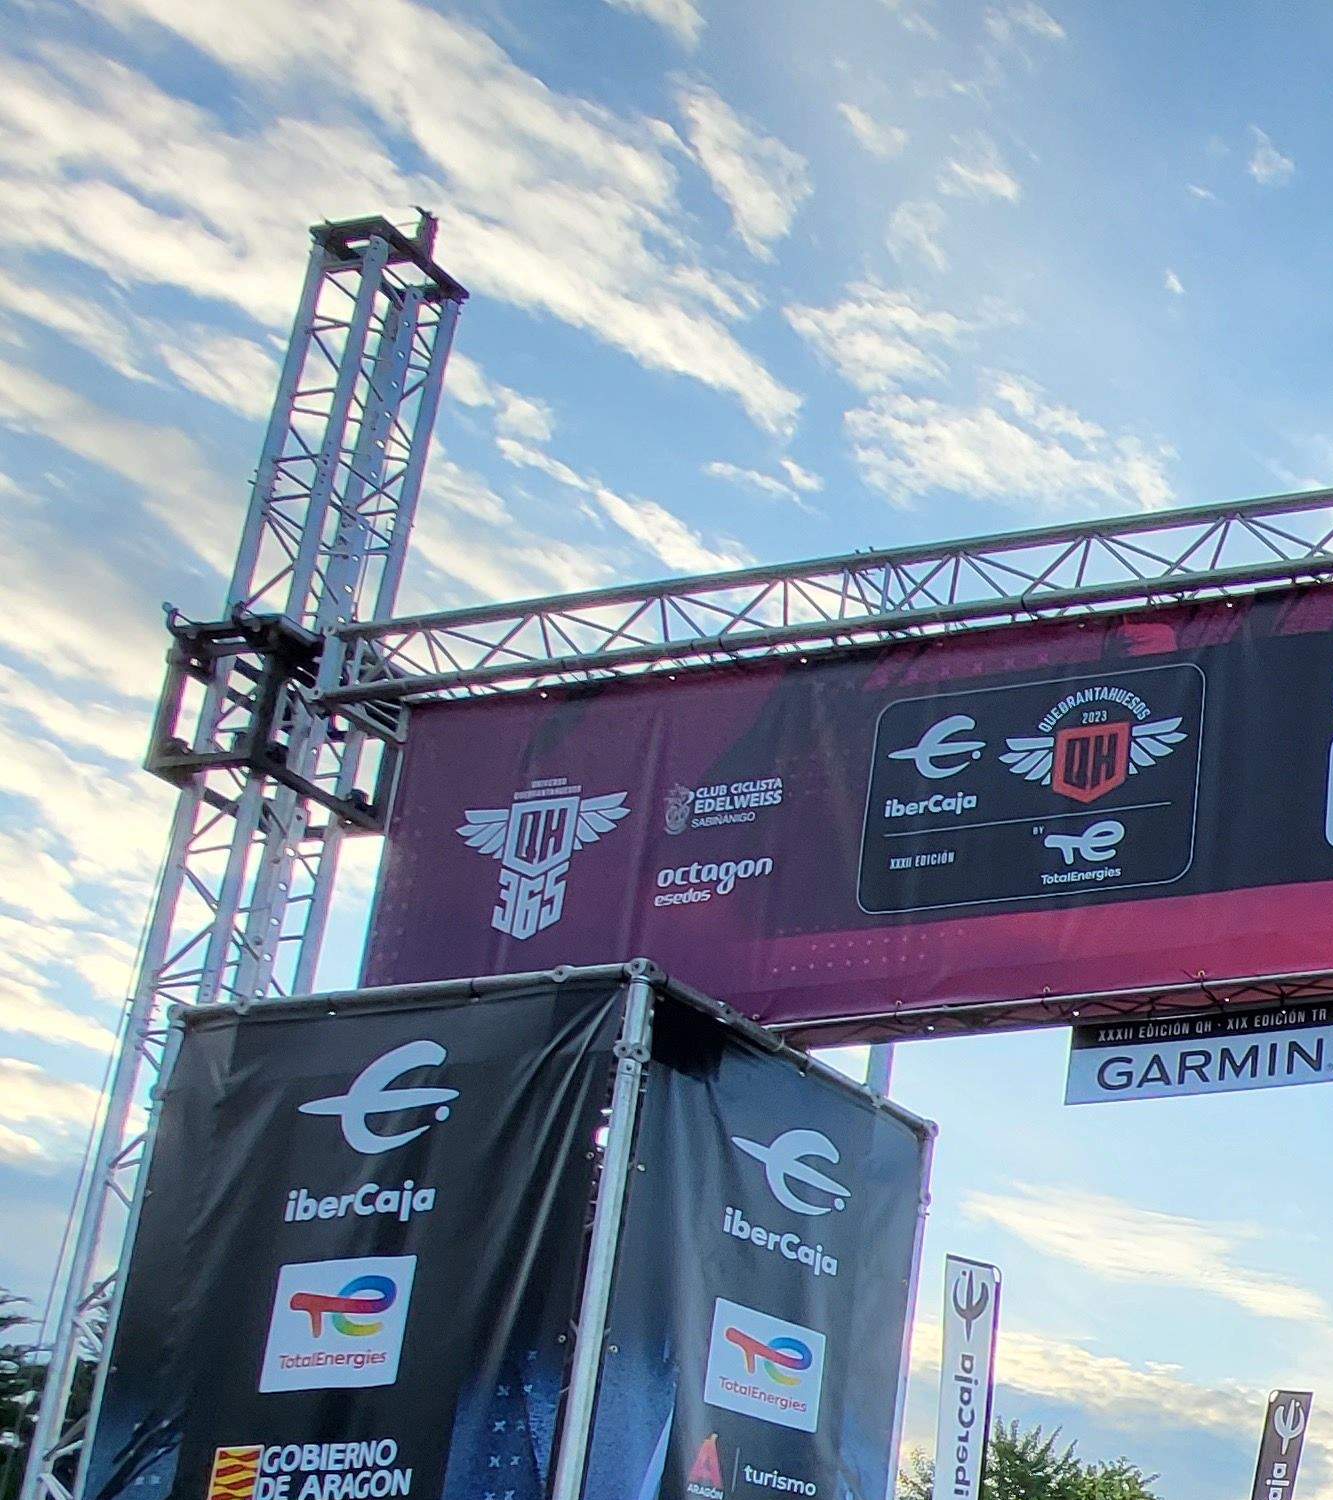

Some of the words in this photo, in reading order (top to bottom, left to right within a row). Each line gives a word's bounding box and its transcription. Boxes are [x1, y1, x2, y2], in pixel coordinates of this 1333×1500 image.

[1038, 687, 1151, 733] QUEBRANTAHUESOS
[1082, 711, 1107, 724] 2023
[694, 790, 783, 814] EDELWEISS
[696, 784, 728, 798] CLUB
[731, 777, 783, 794] CICLISTA
[884, 791, 977, 818] iberCaja
[1032, 825, 1045, 835] BY
[658, 857, 773, 895] octagon
[889, 857, 912, 870] XXXII
[915, 852, 954, 868] EDICIÓN
[1041, 866, 1122, 885] TotalEnergies
[491, 861, 570, 939] 365
[654, 888, 711, 907] esedos
[1098, 1029, 1133, 1042] XXXII
[1139, 1022, 1190, 1038] EDICIÓN
[1195, 1021, 1212, 1034] QH
[1227, 1017, 1248, 1030] XIX
[1254, 1010, 1306, 1027] EDICIÓN
[1311, 1008, 1327, 1021] TR
[1097, 1038, 1324, 1091] GARMIN
[284, 1180, 437, 1223] iberCaja
[722, 1206, 838, 1276] iberCaja
[279, 1349, 387, 1369] TotalEnergies
[719, 1376, 807, 1413] TotalEnergies
[261, 1438, 398, 1474] GOBIERNO
[687, 1483, 724, 1500] ARAGÓN
[744, 1464, 817, 1497] turismo
